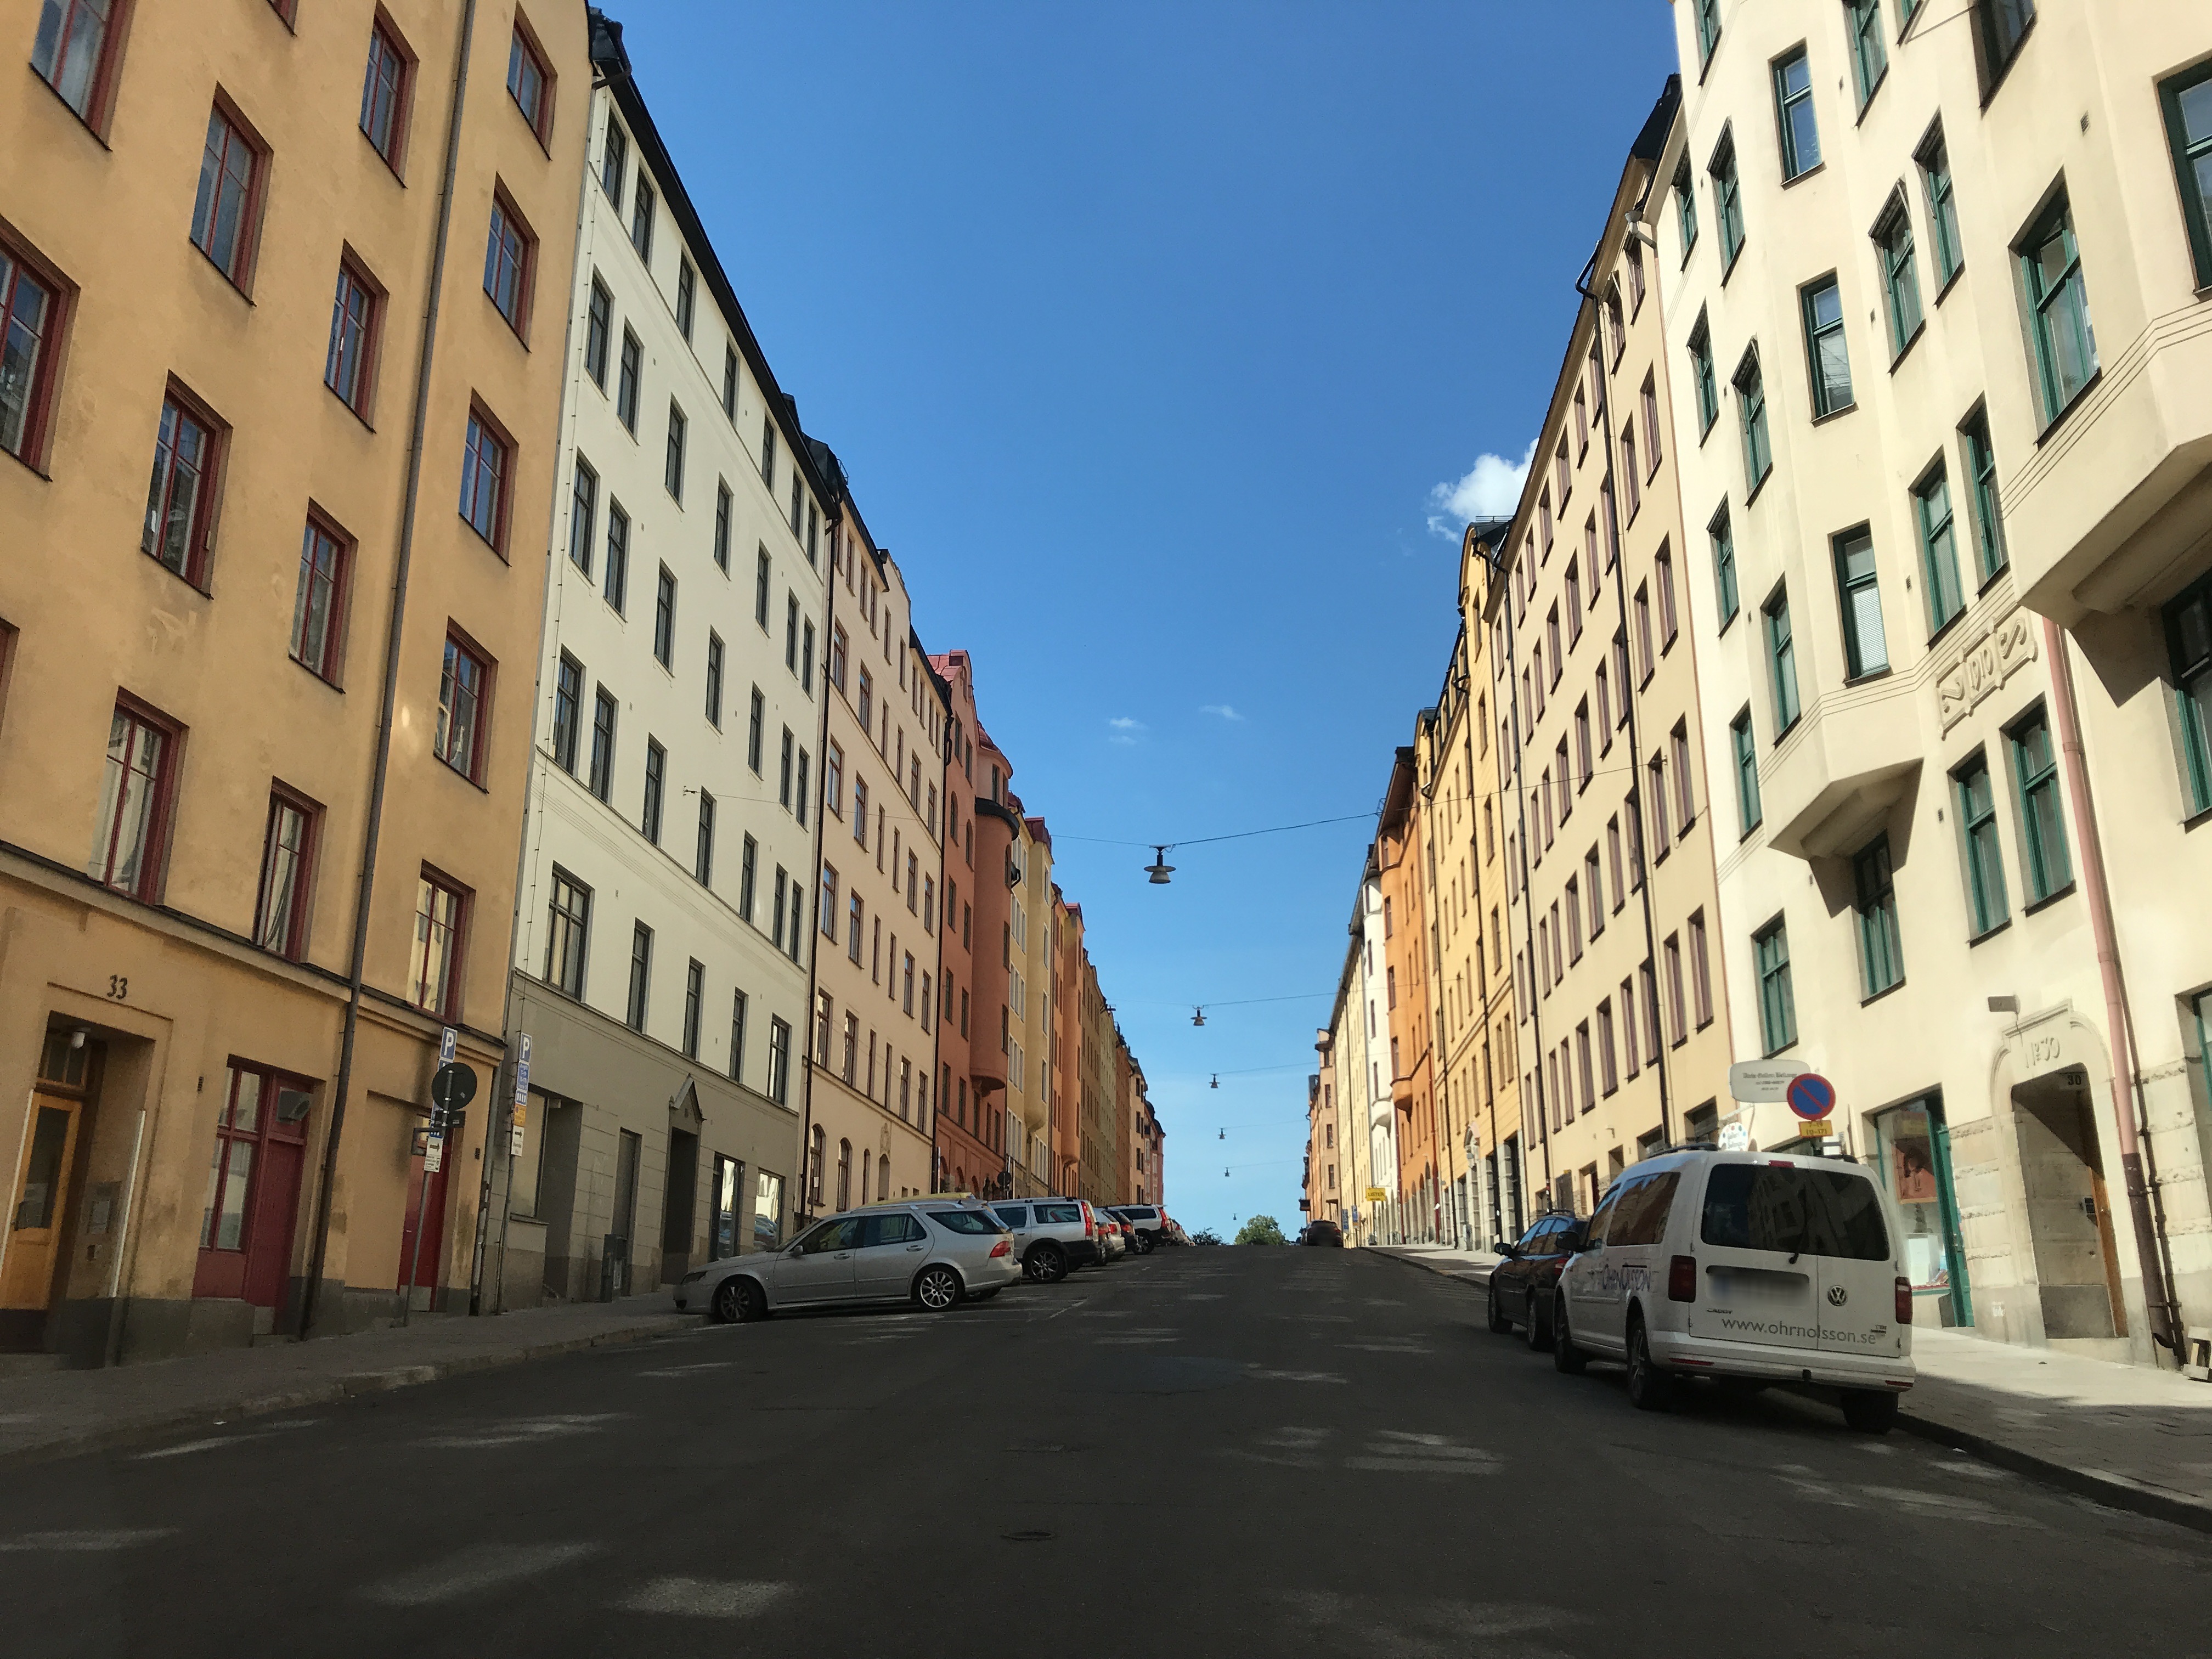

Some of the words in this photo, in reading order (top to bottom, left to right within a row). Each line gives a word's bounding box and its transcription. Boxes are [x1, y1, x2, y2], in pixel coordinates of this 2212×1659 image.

[106, 974, 128, 1000] 33
[444, 1031, 454, 1056] P
[522, 1037, 530, 1059] P
[2067, 1075, 2081, 1086] 30
[1722, 1318, 1876, 1345] www.ohrnolsson.se
